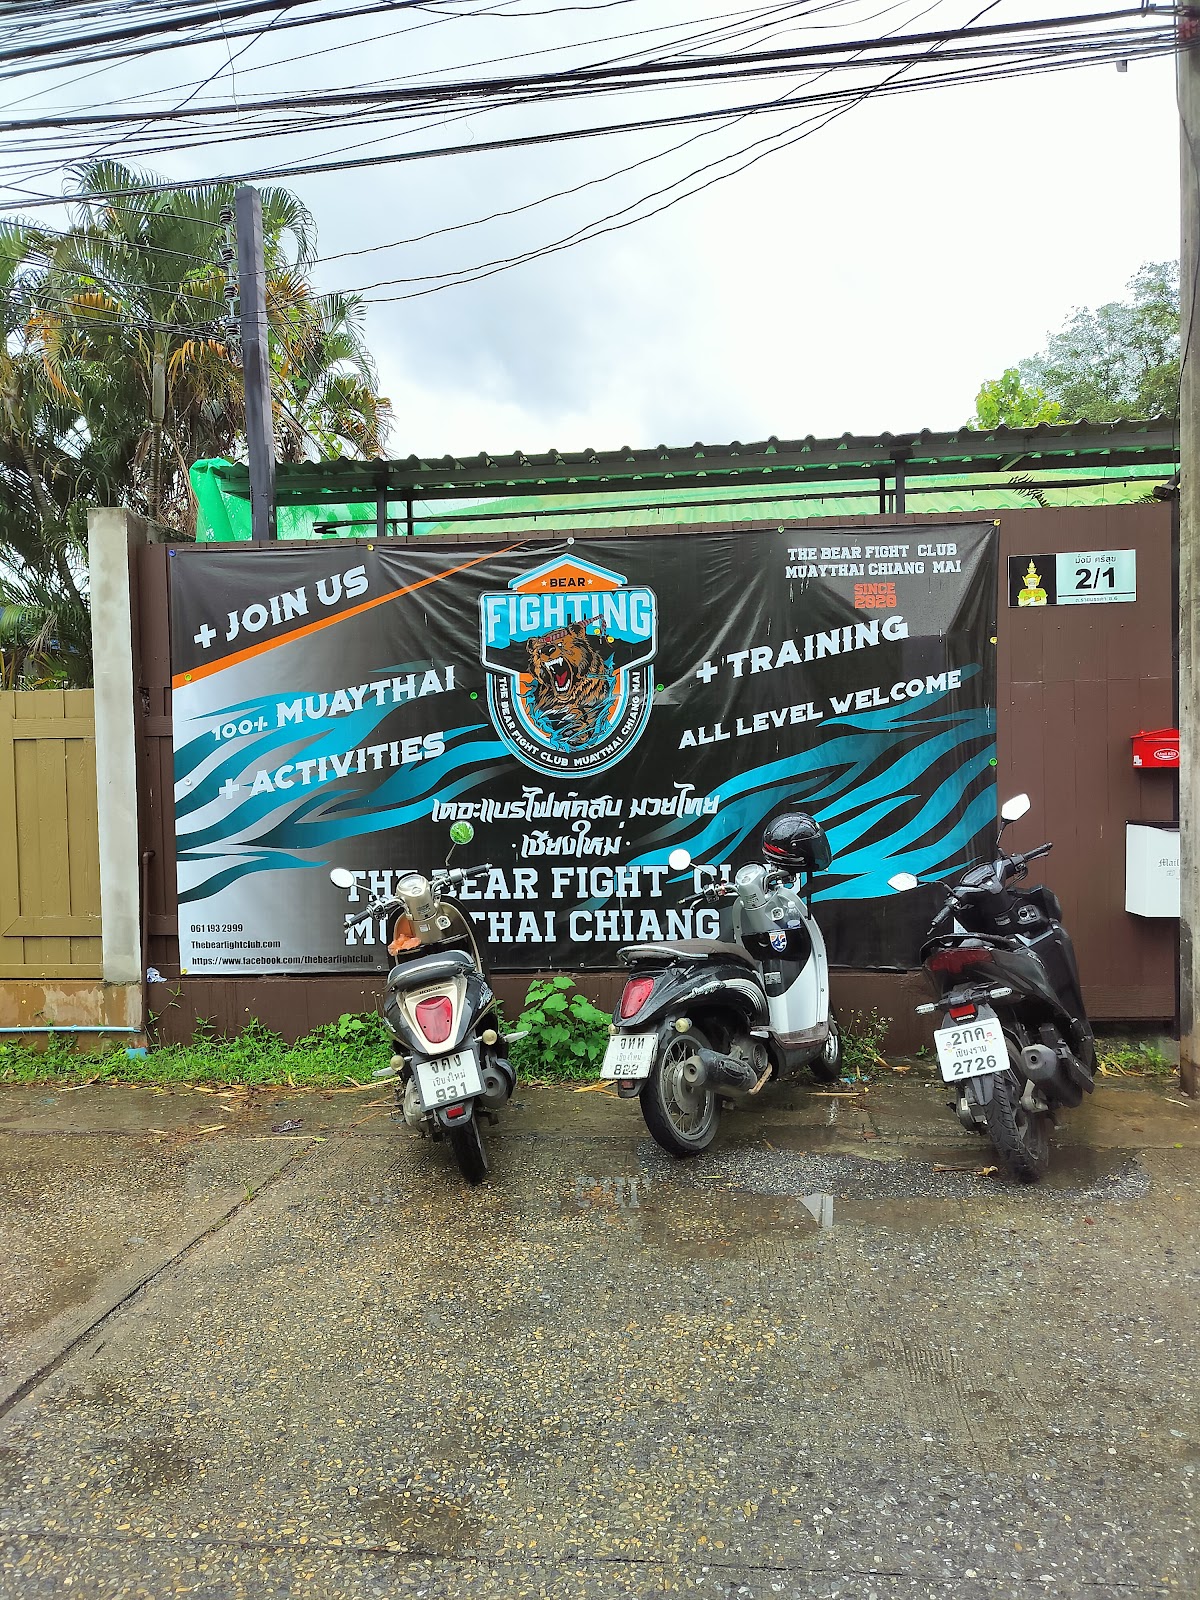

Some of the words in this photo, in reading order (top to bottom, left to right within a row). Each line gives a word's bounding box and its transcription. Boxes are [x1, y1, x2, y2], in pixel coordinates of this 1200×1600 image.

[787, 547, 817, 561] THE
[820, 546, 862, 560] BEAR
[865, 544, 909, 559] FIGHT
[917, 543, 957, 557] CLUB
[785, 563, 865, 579] MUAYTHAI
[868, 561, 925, 575] CHIANG
[932, 560, 962, 573] MAI
[1075, 567, 1115, 590] 2/1
[550, 577, 586, 588] BEAR
[854, 582, 896, 595] SINCE
[225, 586, 310, 642] JOIN
[315, 564, 370, 607] US
[486, 591, 653, 644] FIGHTING
[726, 615, 910, 680] TRAINING
[498, 676, 508, 699] THE
[631, 671, 641, 693] MAI
[275, 665, 456, 728] MUAYTHAI
[501, 700, 515, 732] BEAR
[621, 696, 640, 736] CHIANG
[678, 722, 731, 750] ALL
[736, 702, 824, 737] LEVEL
[829, 669, 962, 716] WELCOME
[511, 728, 539, 756] FIGHT
[573, 735, 623, 767] MUAYTHAI
[249, 731, 446, 797] ACTIVITIES
[540, 751, 569, 767] CLUB
[628, 781, 721, 819] มวยไทย
[347, 869, 418, 902] TH
[551, 865, 669, 899] FIGHT
[190, 924, 205, 933] 061
[207, 924, 220, 933] 193
[221, 923, 244, 932] 2999
[569, 908, 720, 942] CHIANG
[190, 940, 281, 950] Thebearfightclub.com
[191, 955, 374, 966] https://www.facebook.com/thebearfightclub
[952, 1055, 997, 1076] 2726
[435, 1081, 468, 1103] 931
